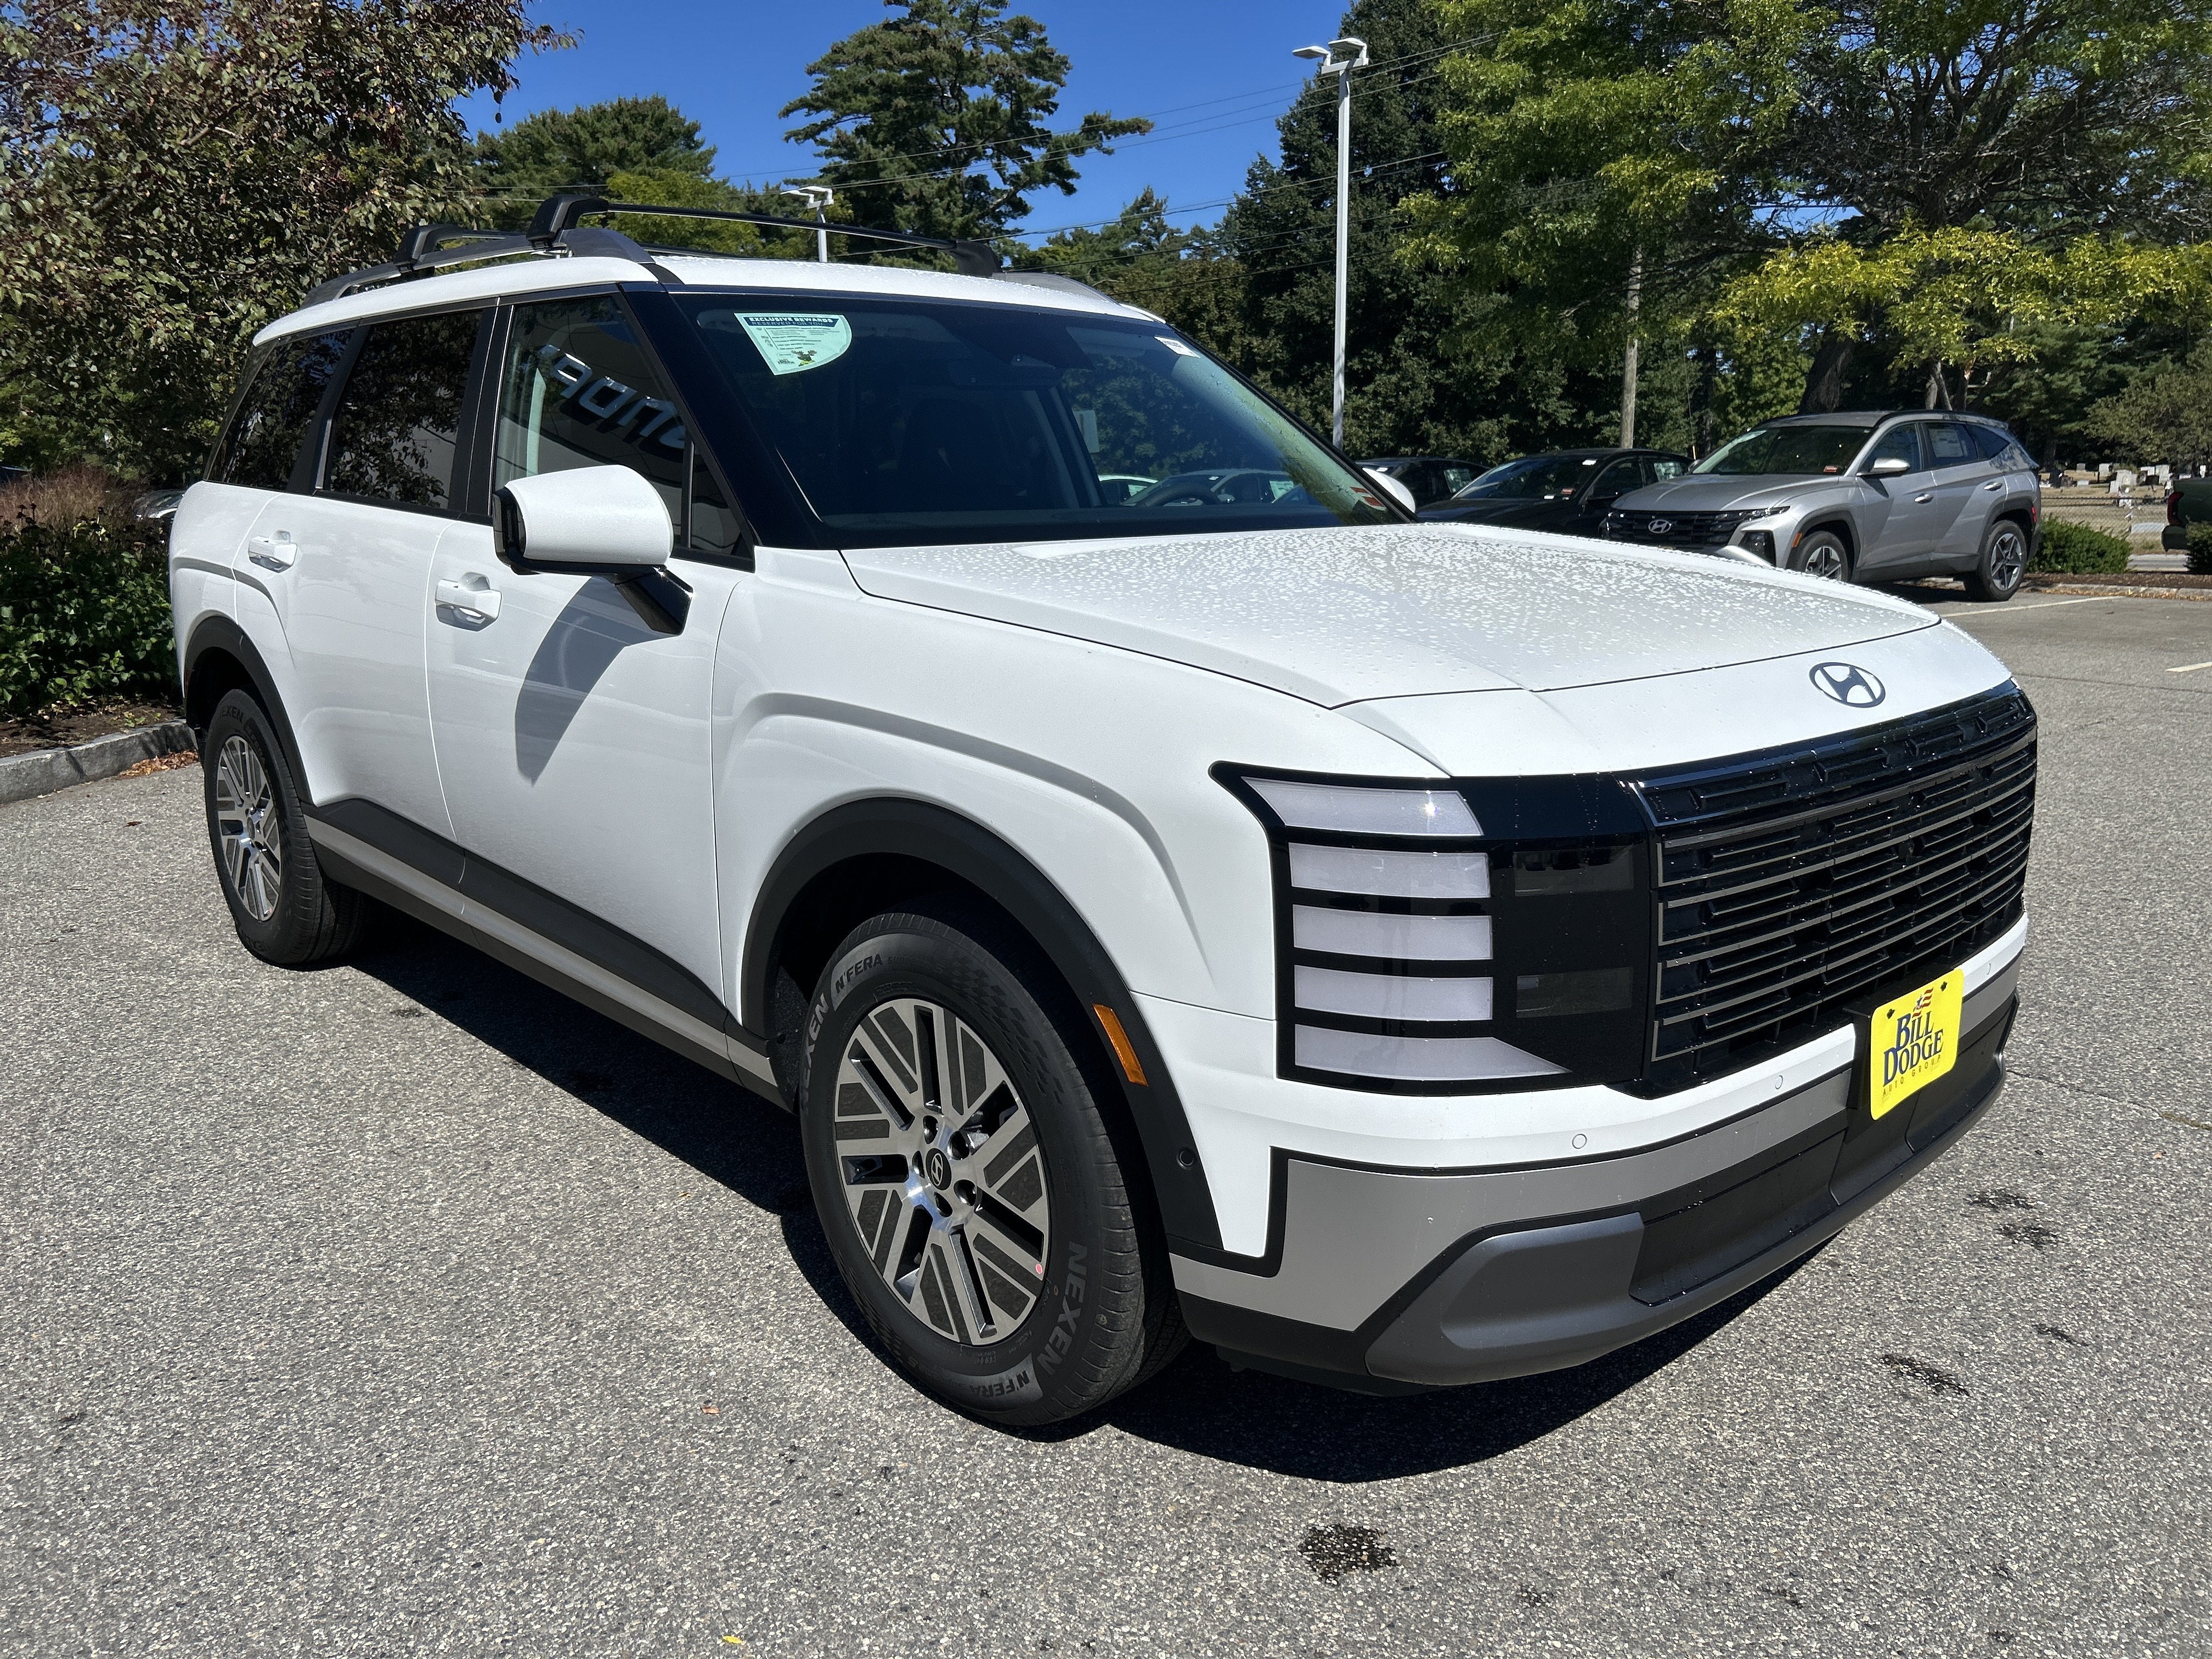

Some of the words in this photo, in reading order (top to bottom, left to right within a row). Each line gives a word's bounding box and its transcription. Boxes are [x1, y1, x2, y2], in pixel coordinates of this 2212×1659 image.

[835, 953, 884, 994] N'FERA
[1896, 1011, 1934, 1052] BILL
[1883, 1029, 1944, 1087] DODGE
[1883, 1076, 1904, 1097] AUTO
[1912, 1054, 1941, 1076] GROUP
[1037, 1241, 1087, 1375] NEXEN
[969, 1370, 1030, 1397] N'FERA
